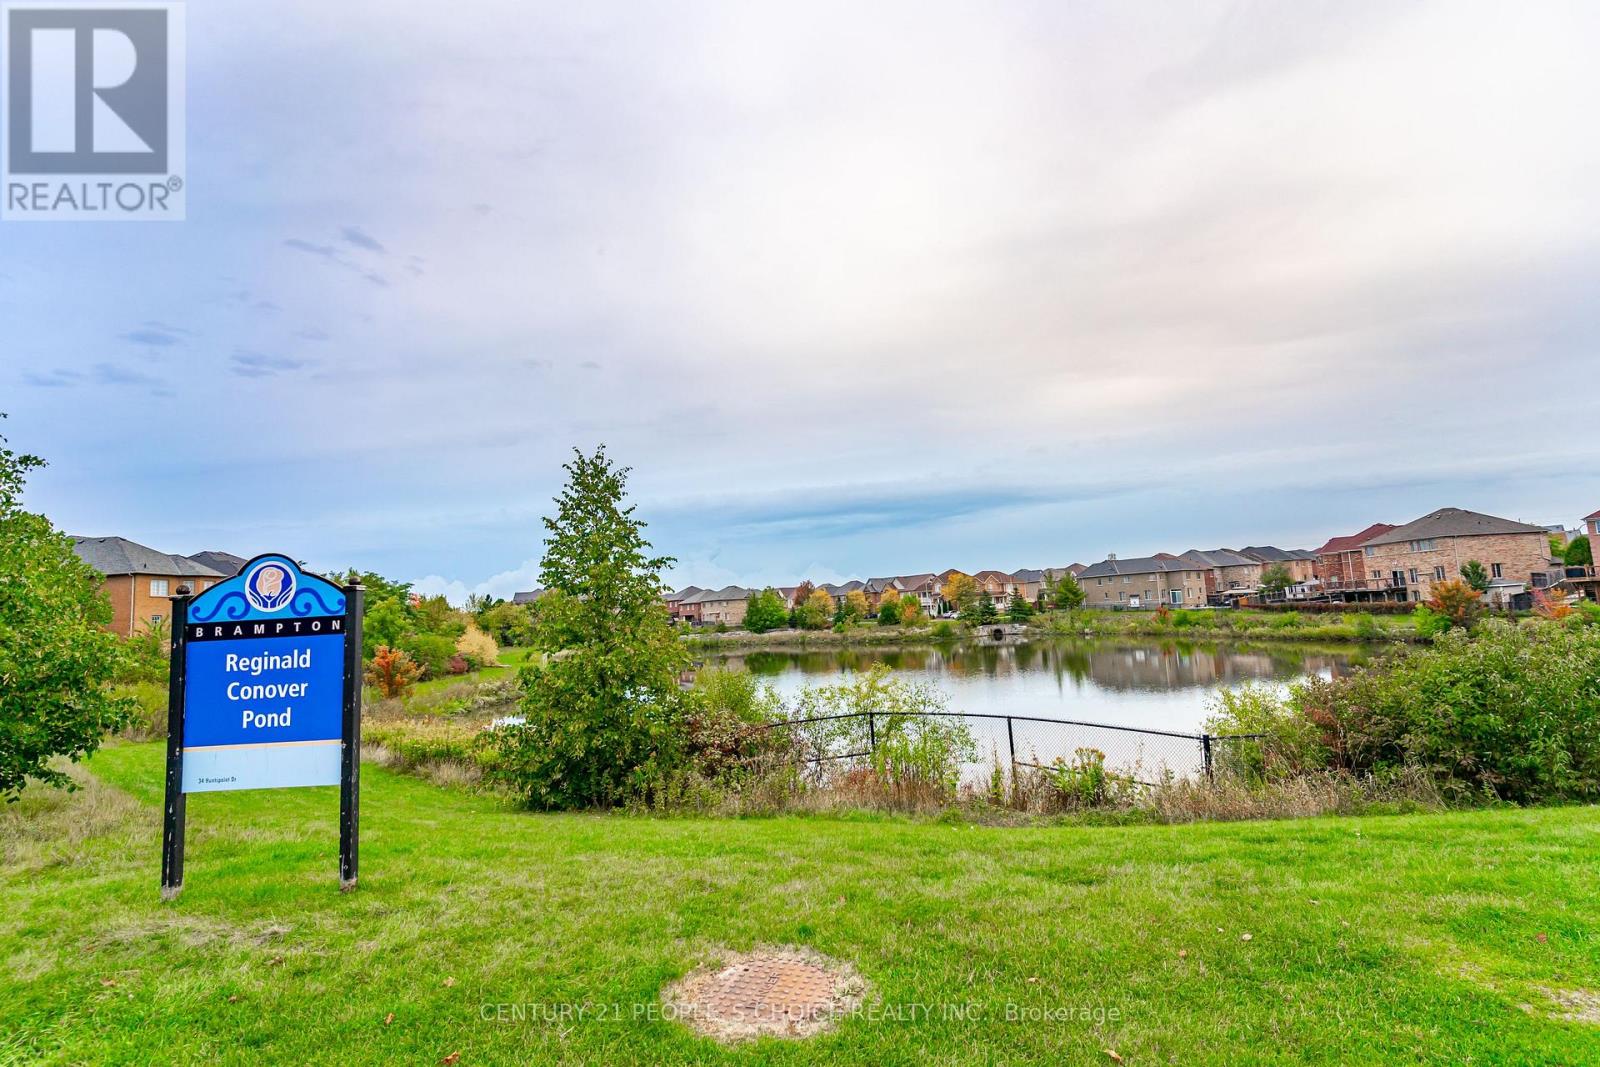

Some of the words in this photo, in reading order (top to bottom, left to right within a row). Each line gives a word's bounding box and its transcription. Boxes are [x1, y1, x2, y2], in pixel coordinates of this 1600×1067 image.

[195, 619, 341, 638] BRAMPTON
[225, 648, 311, 675] Reginald
[226, 682, 308, 700] Conover
[242, 707, 292, 729] Pond
